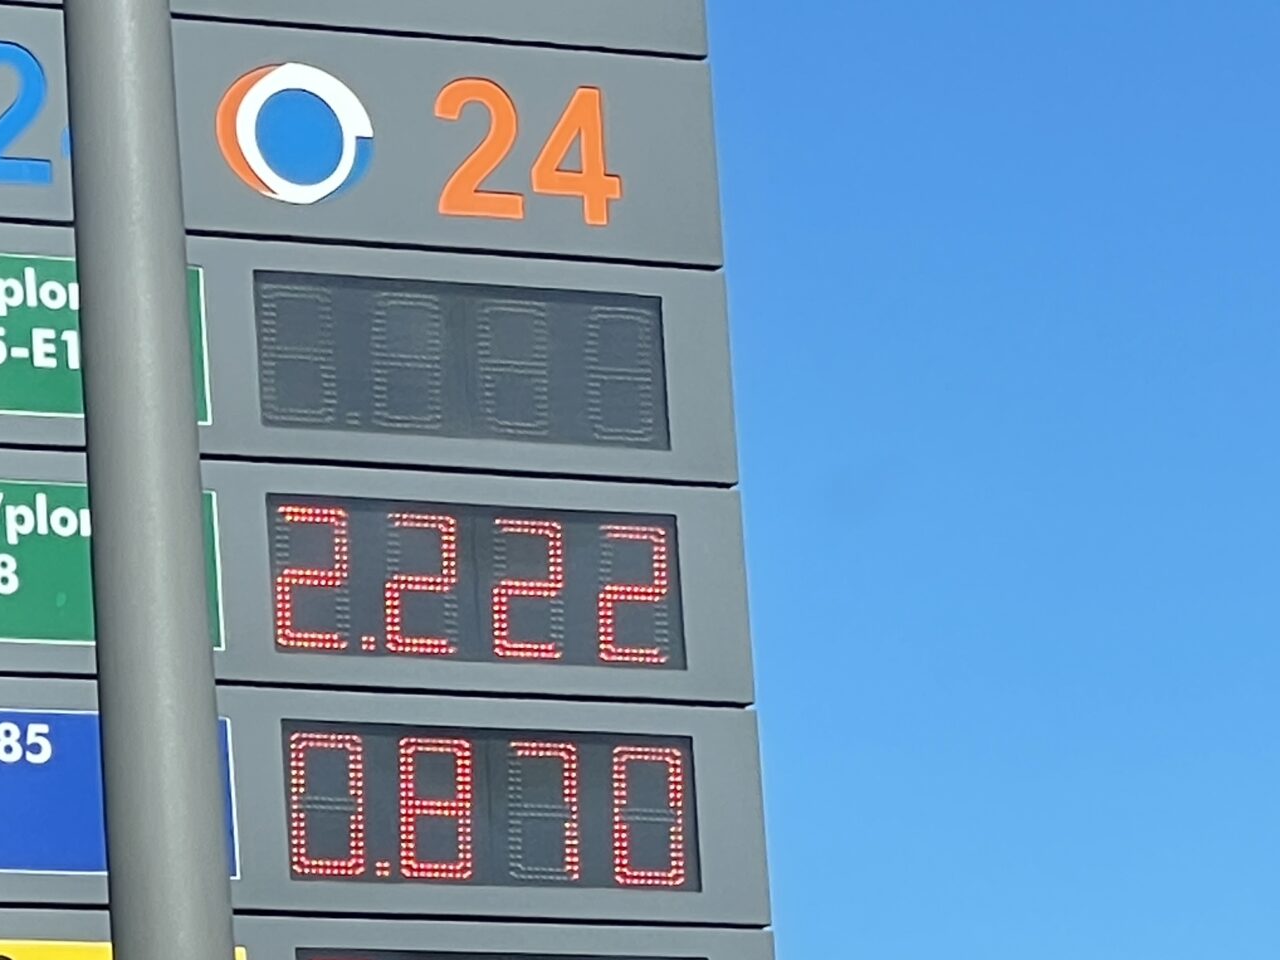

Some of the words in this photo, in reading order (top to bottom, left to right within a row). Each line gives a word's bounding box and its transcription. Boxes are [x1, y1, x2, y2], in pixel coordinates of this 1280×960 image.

[434, 77, 622, 225] 24
[275, 505, 667, 664] 2.222
[290, 733, 685, 886] 0.870
